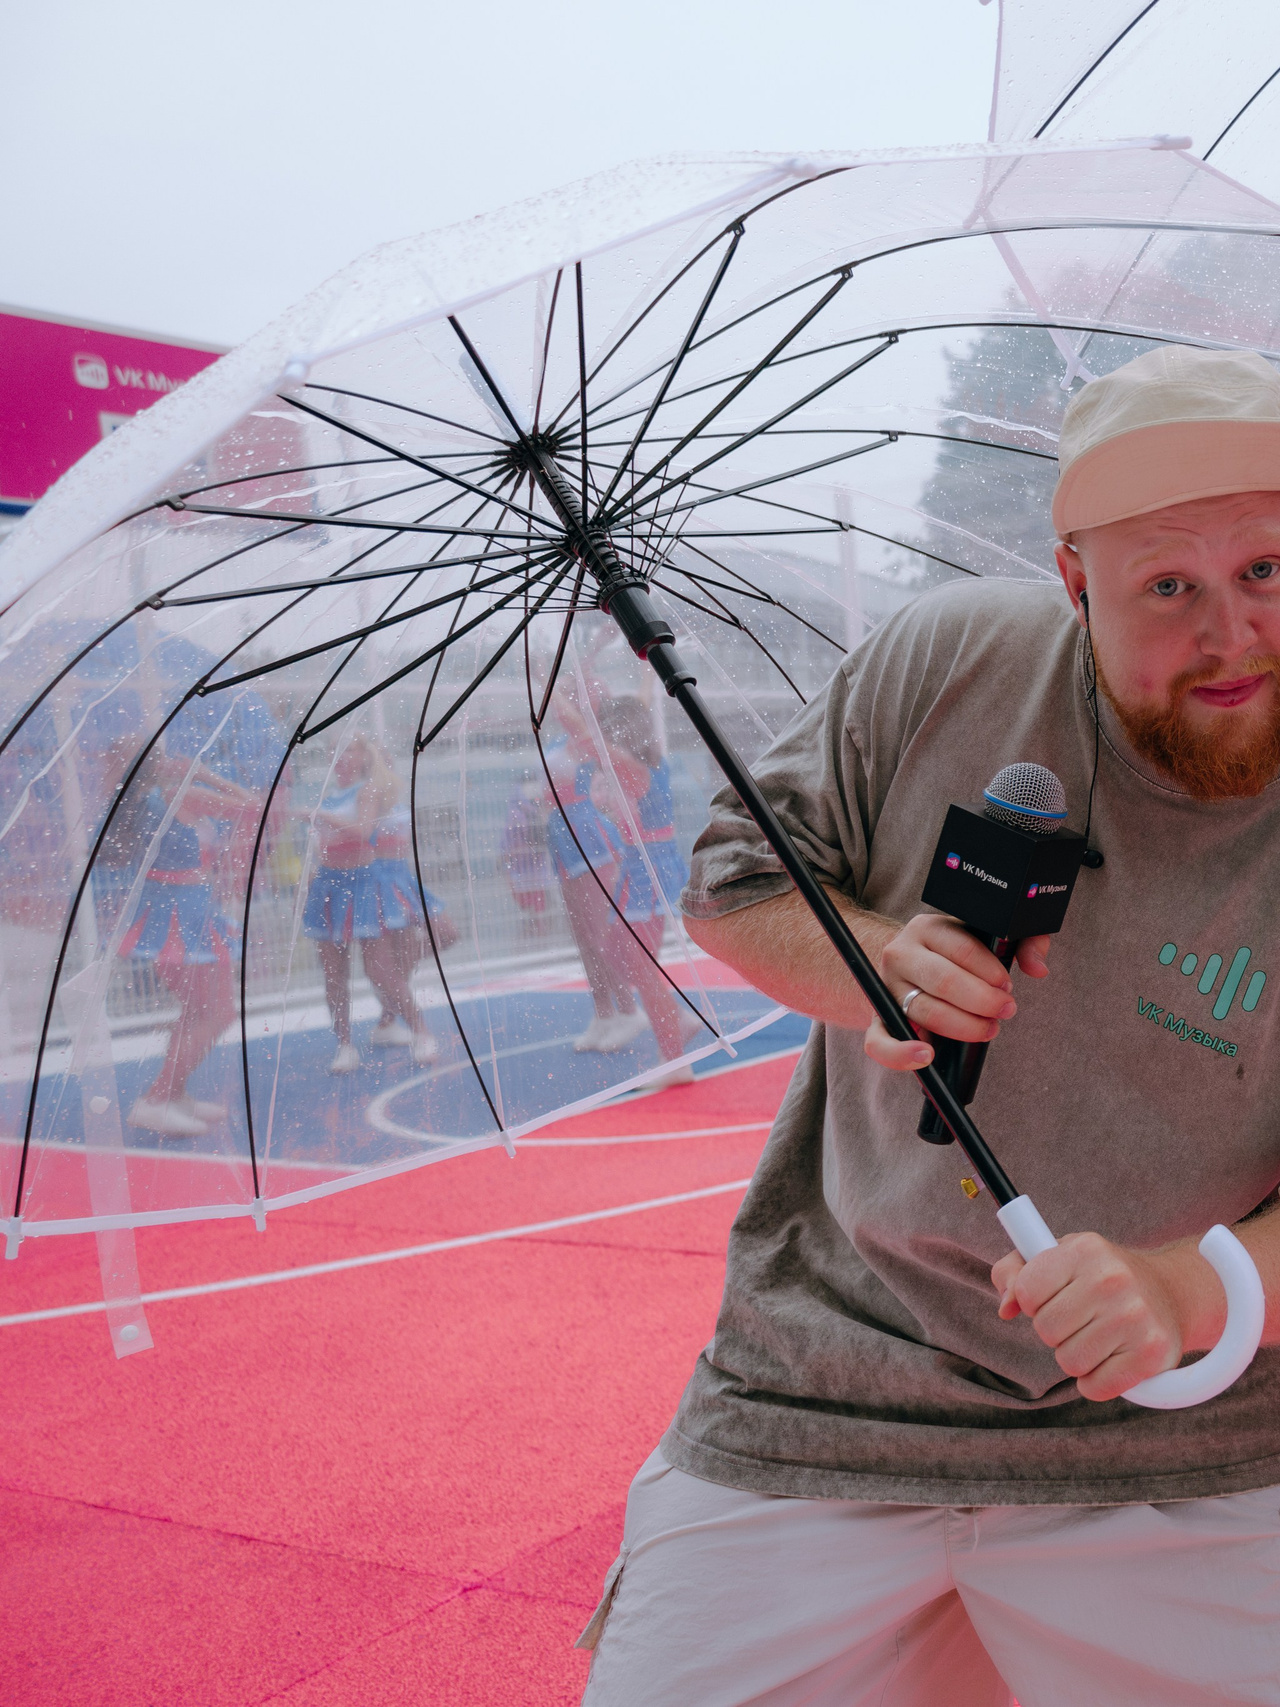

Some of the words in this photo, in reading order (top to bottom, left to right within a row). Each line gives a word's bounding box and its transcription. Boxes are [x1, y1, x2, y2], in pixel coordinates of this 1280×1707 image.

[113, 364, 145, 389] VK
[962, 861, 976, 874] VK
[974, 867, 1008, 889] Музыка
[1137, 996, 1165, 1025] VK
[1163, 1012, 1239, 1058] Музыка
